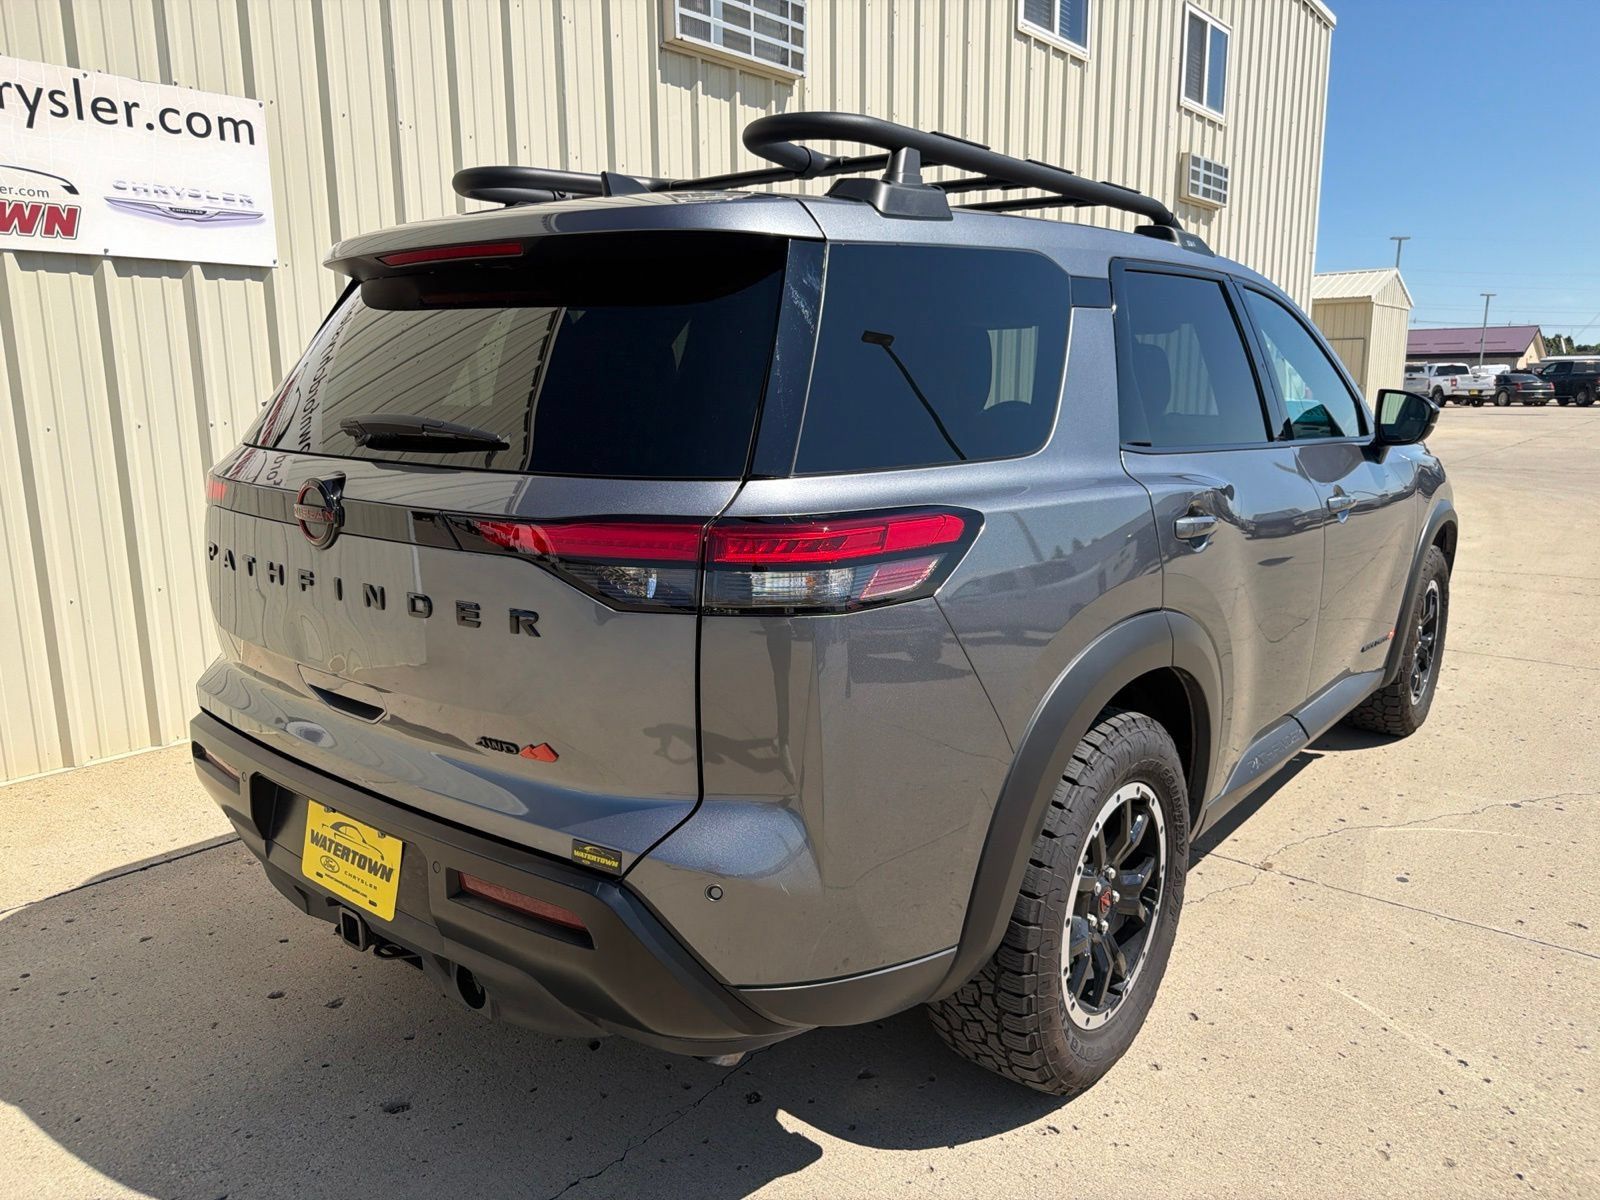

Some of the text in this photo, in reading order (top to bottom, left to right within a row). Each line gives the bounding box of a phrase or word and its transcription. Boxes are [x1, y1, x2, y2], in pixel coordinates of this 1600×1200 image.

[112, 179, 255, 207] CHRYSLER
[207, 540, 541, 638] PATHFINDER
[475, 736, 520, 755] 4WD
[310, 829, 394, 883] WATERTOWN
[573, 849, 619, 868] WATERTOWN
[343, 870, 378, 891] CHRYSLER
